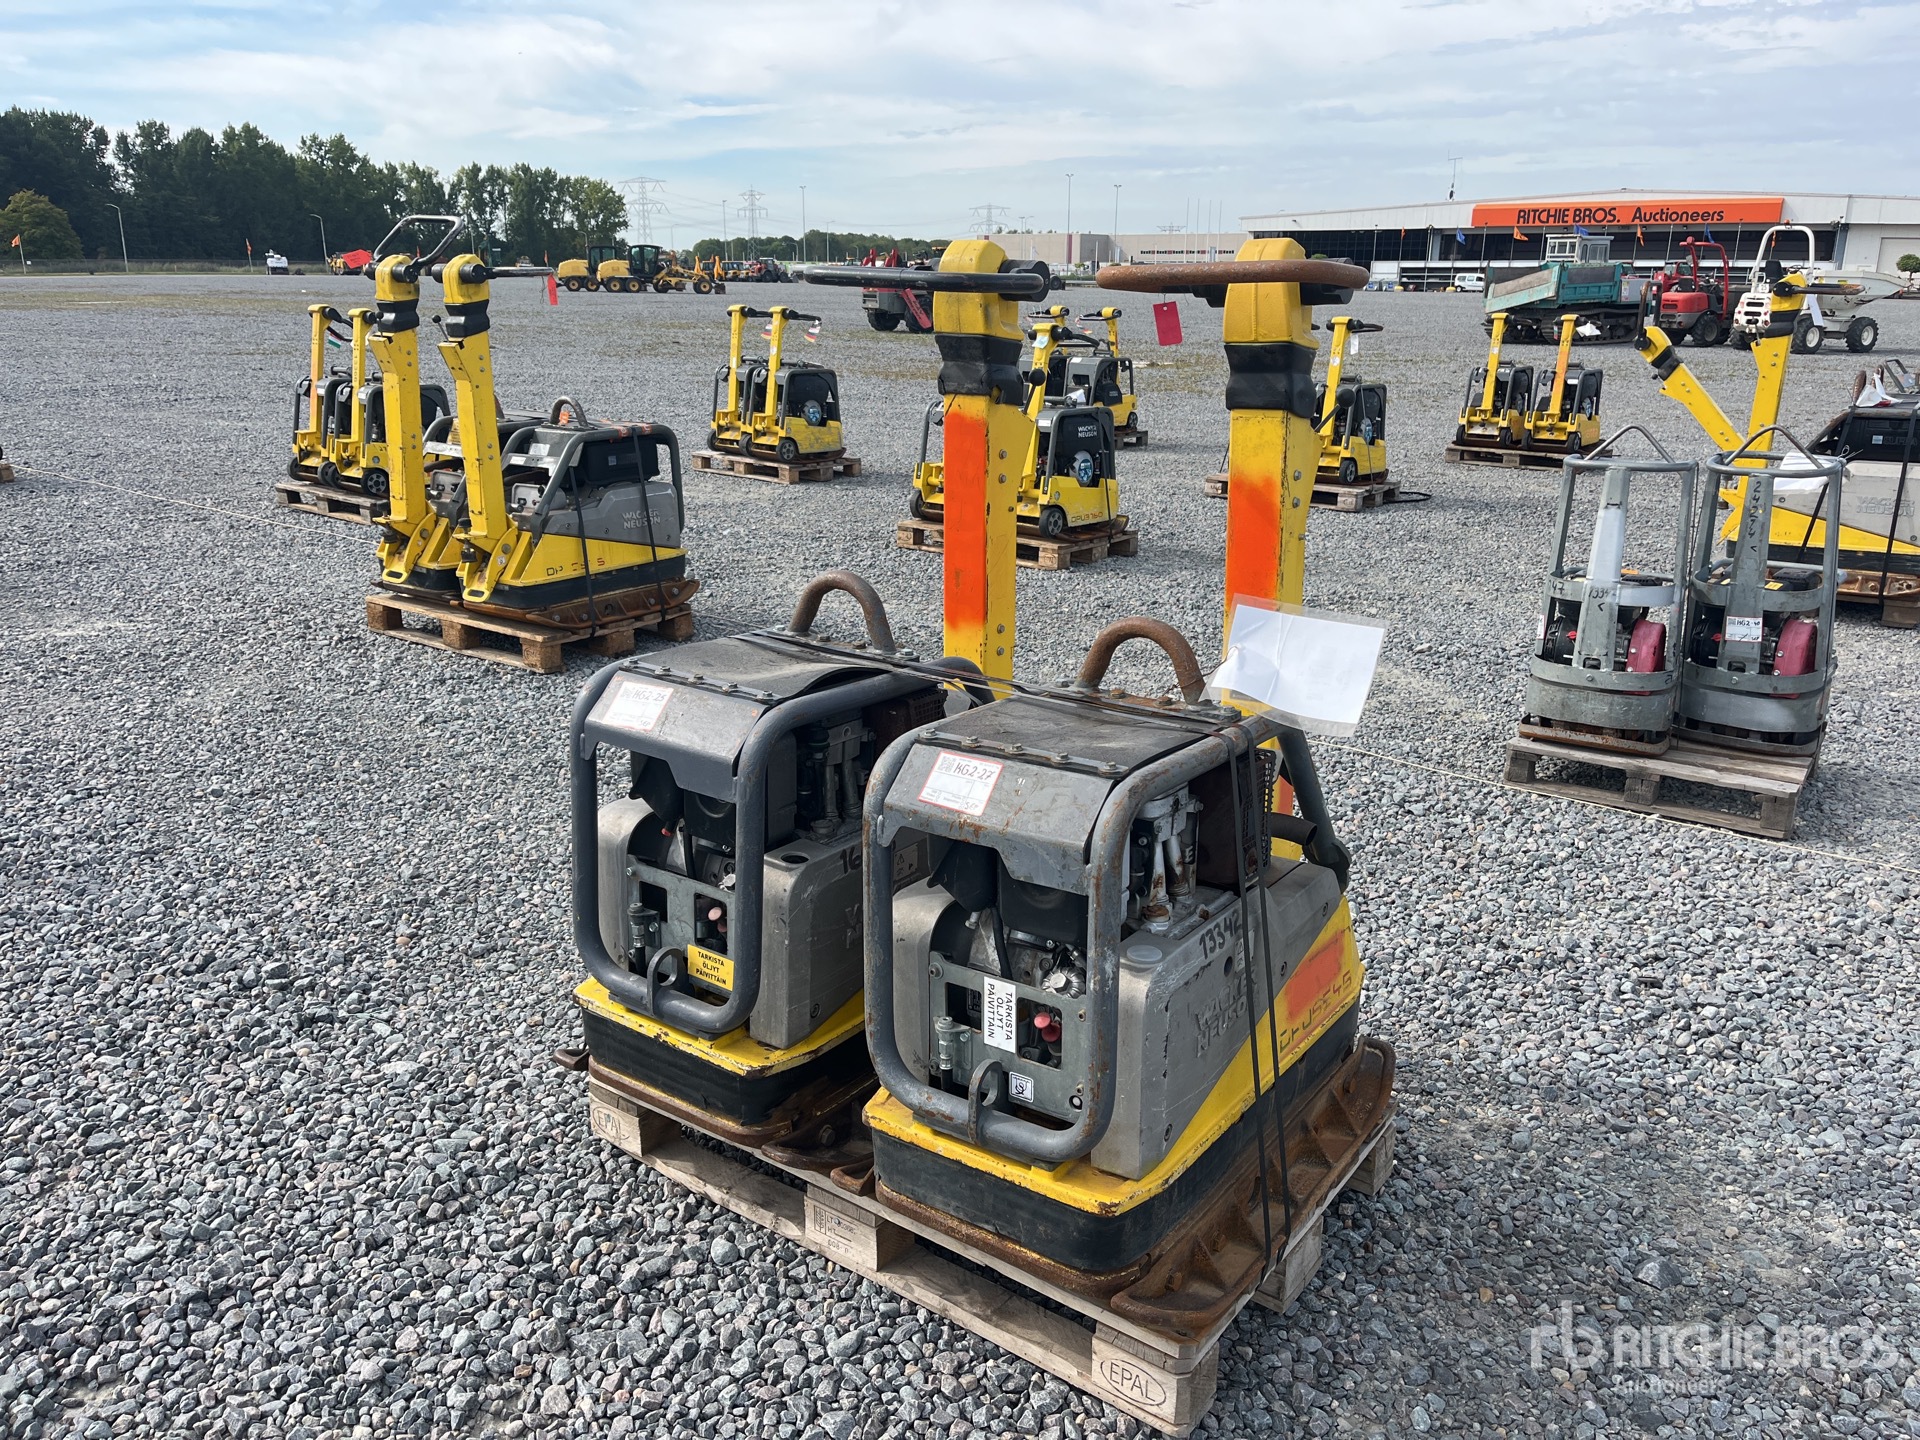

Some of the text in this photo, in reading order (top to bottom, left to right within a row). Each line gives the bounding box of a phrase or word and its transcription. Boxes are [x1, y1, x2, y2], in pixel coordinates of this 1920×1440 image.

[1517, 206, 1724, 224] RITCHIE BROS. Auctioneers
[697, 950, 725, 967] TARKISTA
[1005, 992, 1013, 1041] TARKISTA
[1109, 1361, 1156, 1403] EPAL
